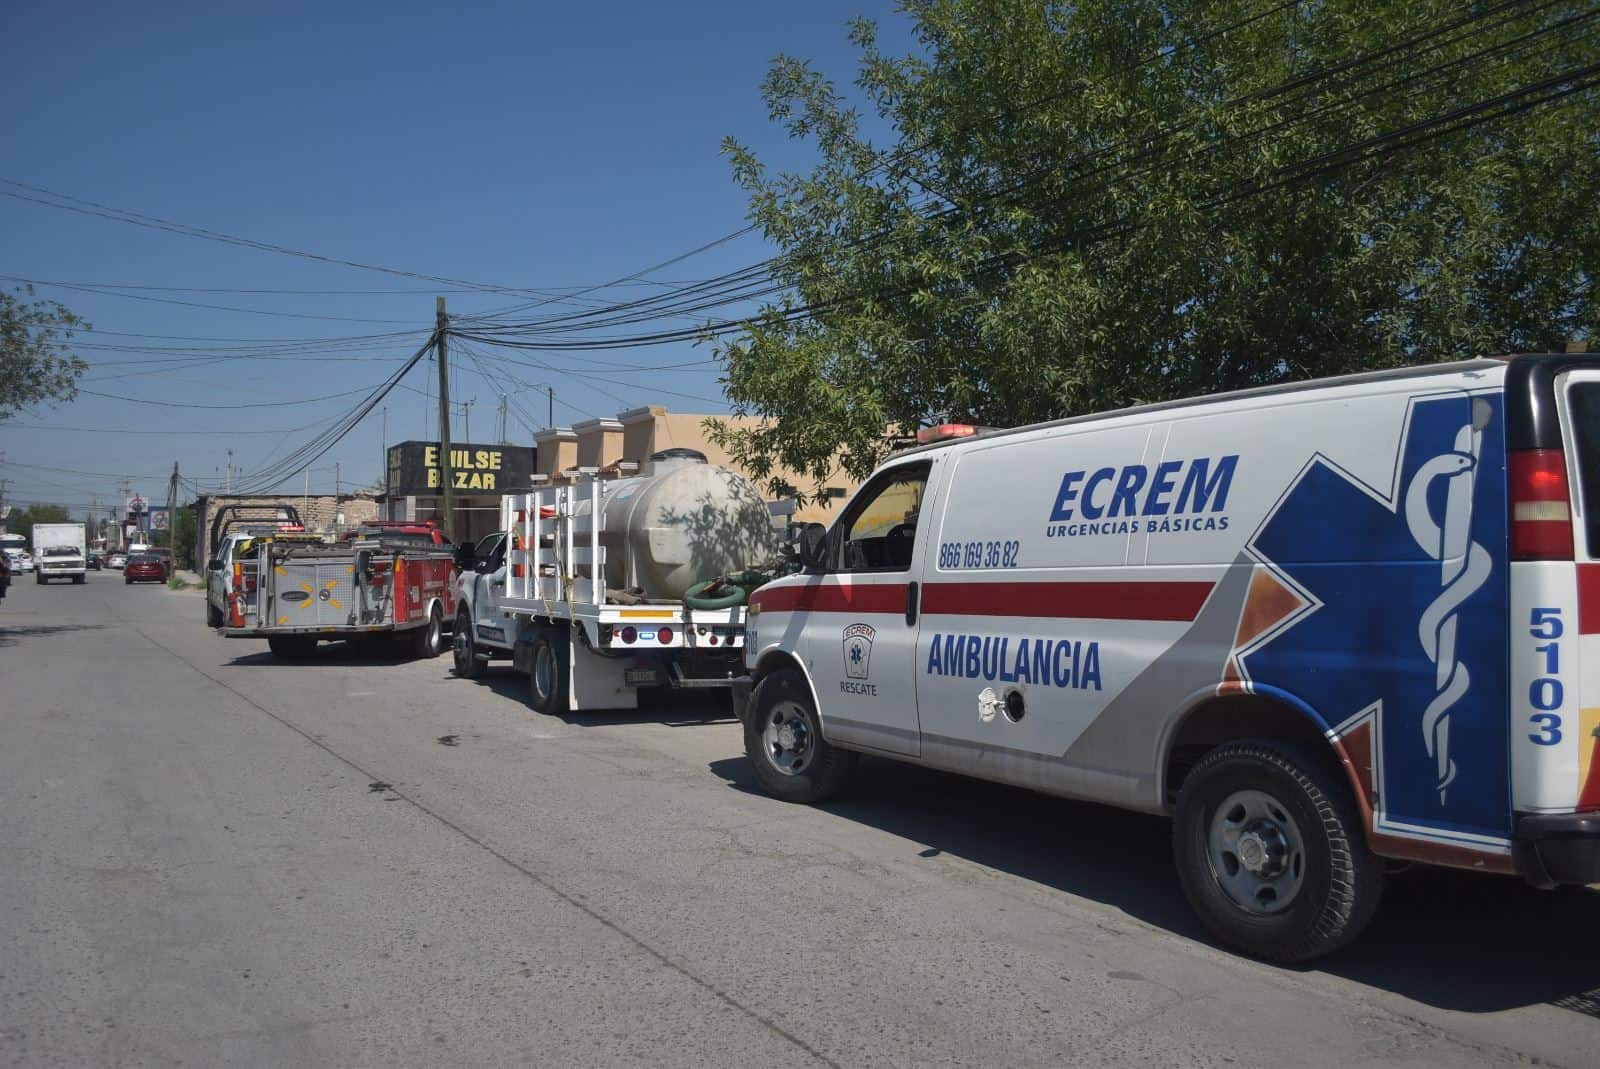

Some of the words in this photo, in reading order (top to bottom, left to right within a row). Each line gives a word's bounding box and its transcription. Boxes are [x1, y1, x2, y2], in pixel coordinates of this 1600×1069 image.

[424, 446, 502, 470] EILSE
[427, 468, 496, 490] BZAR
[1049, 455, 1240, 521] ECREM
[1046, 520, 1139, 538] URGENCIAS
[1147, 517, 1229, 533] BÁSICAS
[940, 542, 961, 568] 866
[964, 542, 982, 568] 169
[985, 541, 1001, 567] 36
[1003, 540, 1019, 567] 82
[846, 626, 873, 640] ECREM
[927, 633, 1103, 691] AMBULANCIA
[840, 681, 878, 697] RESCATE
